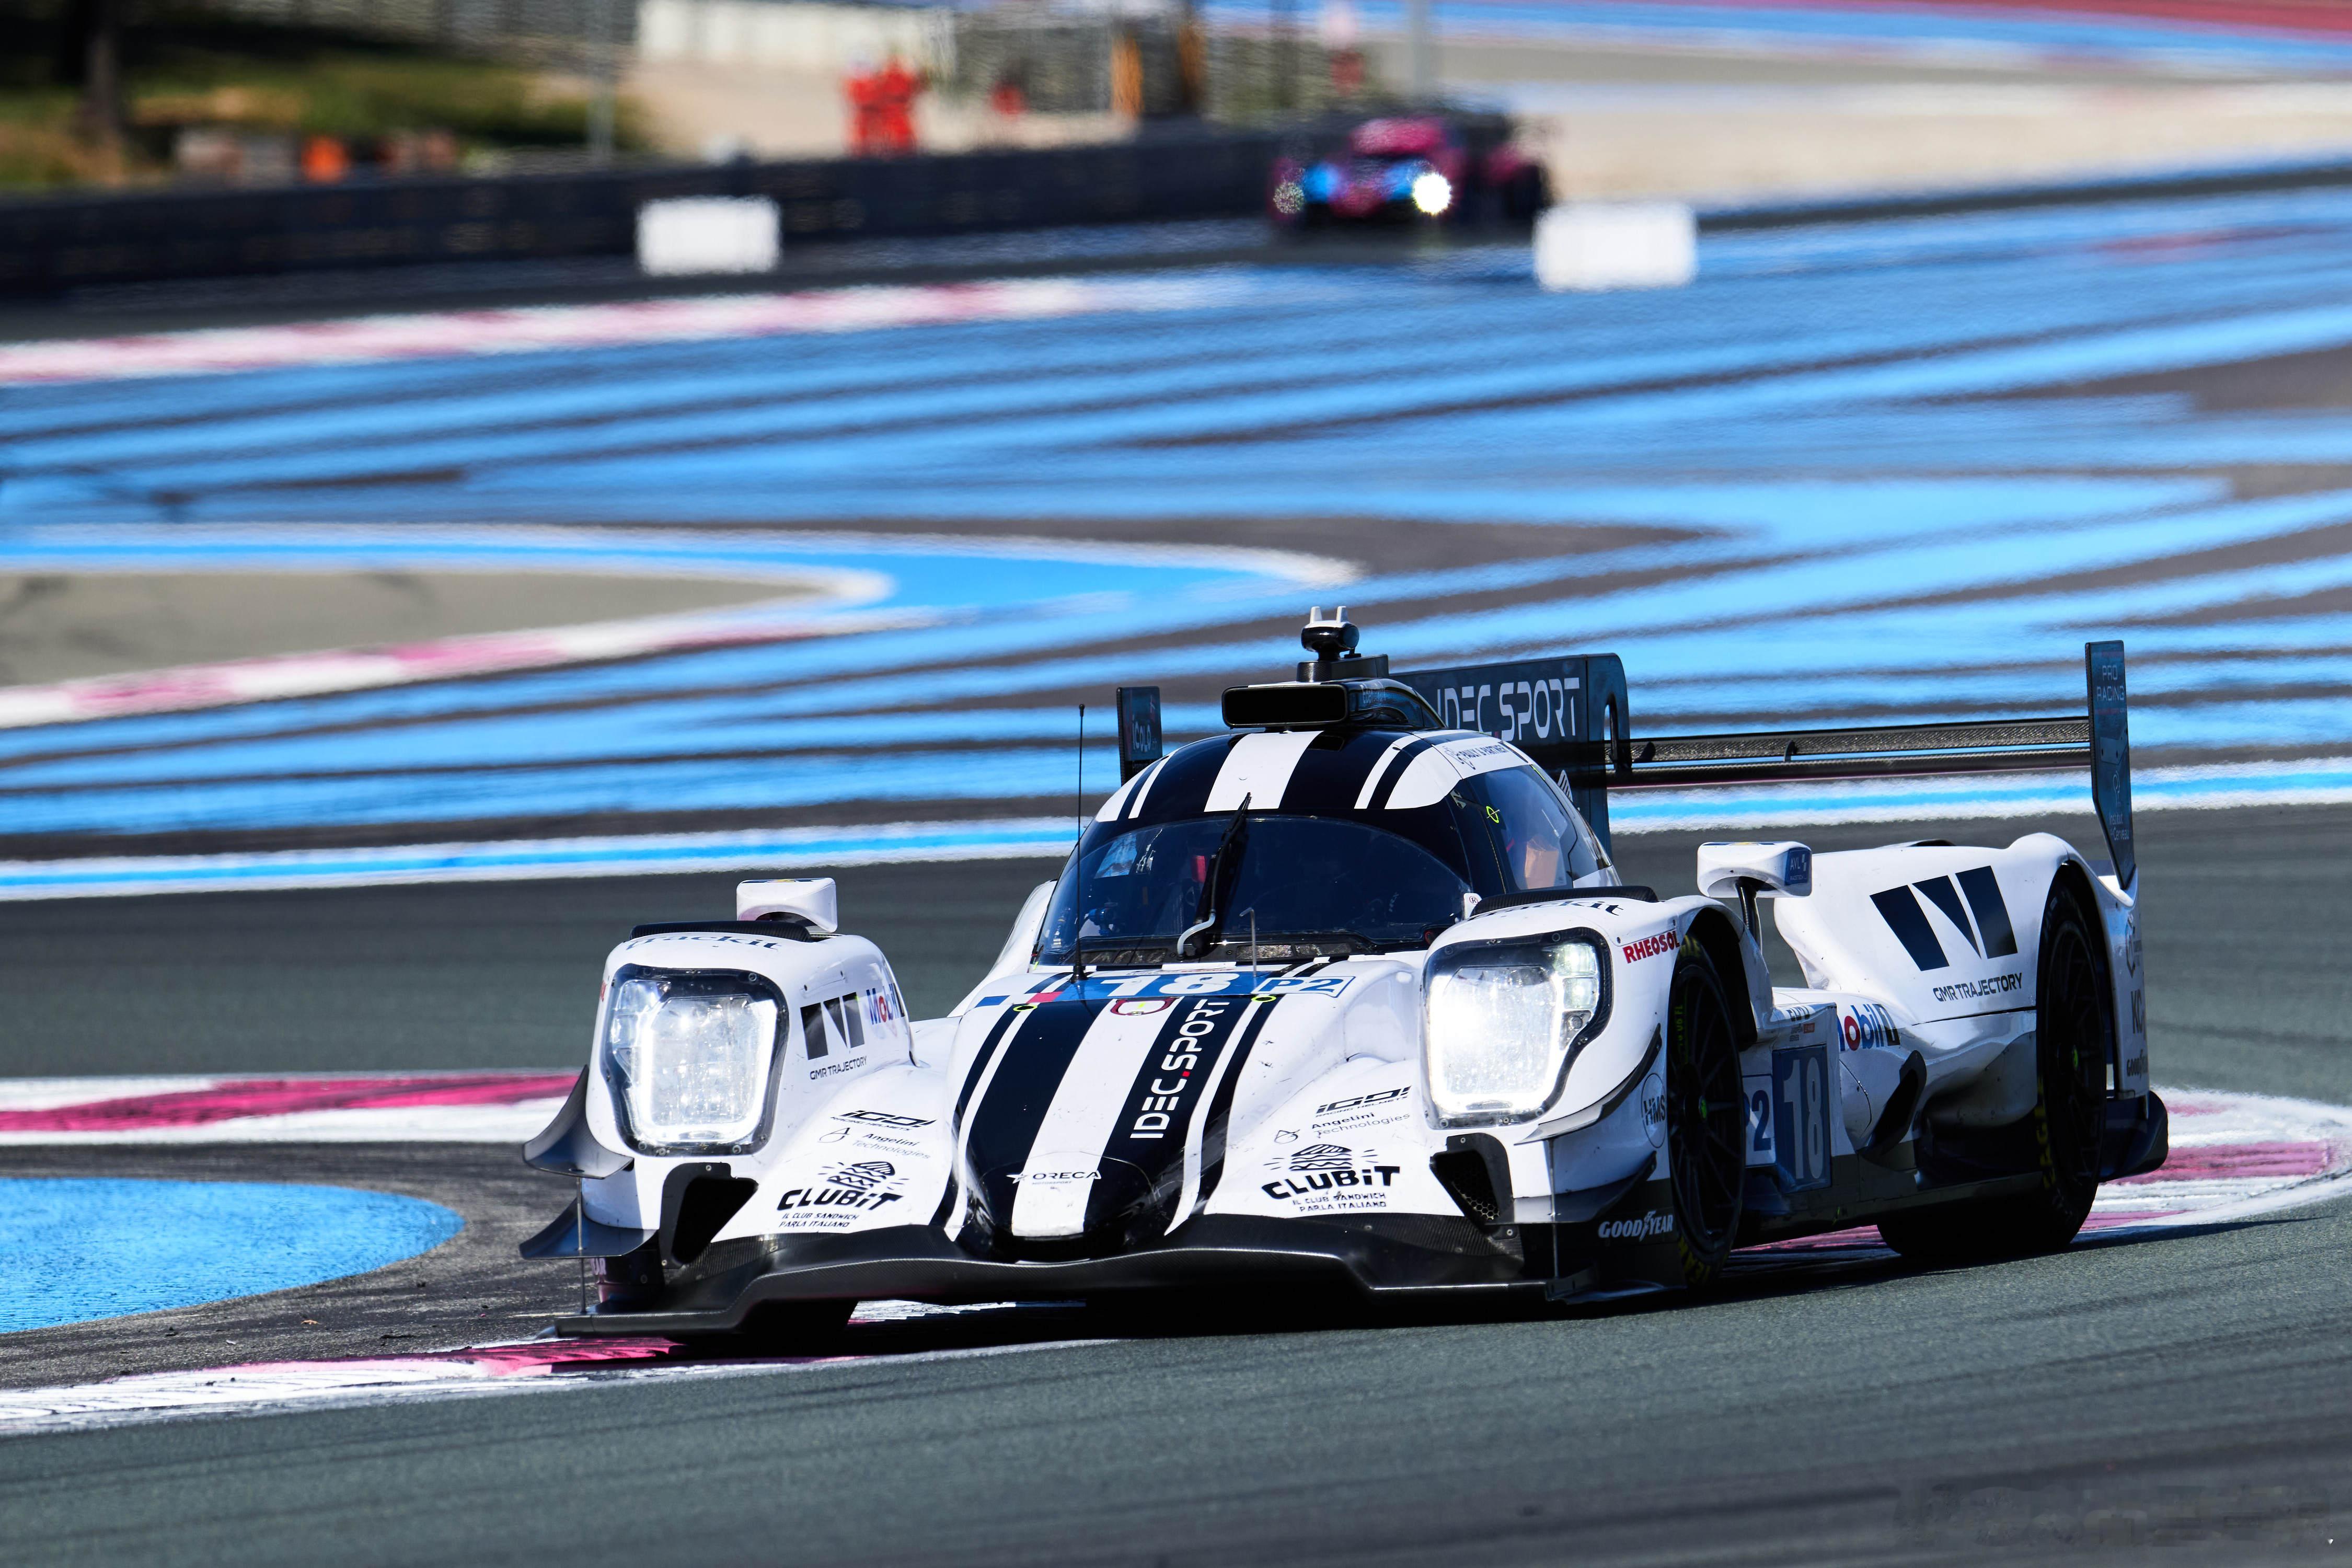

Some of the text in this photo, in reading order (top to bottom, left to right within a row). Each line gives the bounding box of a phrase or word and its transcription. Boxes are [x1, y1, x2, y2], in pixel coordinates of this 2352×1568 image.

[2102, 665, 2118, 681] PRO
[2097, 686, 2125, 702] RACING
[1790, 858, 1801, 870] AVL
[1622, 930, 1680, 964] RHEOSOL
[1101, 973, 1240, 996] 18
[1258, 978, 1344, 993] P2
[1933, 972, 2022, 1002] GMR TRAJECTORY
[810, 1056, 868, 1080] GMR TRAJECTORY
[1316, 1096, 1409, 1117] RACING HELMETS
[866, 1122, 912, 1131] HELMETS
[1311, 1112, 1375, 1129] Angelini
[1313, 1113, 1410, 1134] Technologies
[1783, 1057, 1824, 1180] 18
[863, 1134, 921, 1146] Angelini
[852, 1140, 931, 1159] Technologies
[1333, 1192, 1386, 1201] SANDWICH
[1299, 1204, 1334, 1212] PARLA
[1598, 1210, 1674, 1242] GOODYEAR
